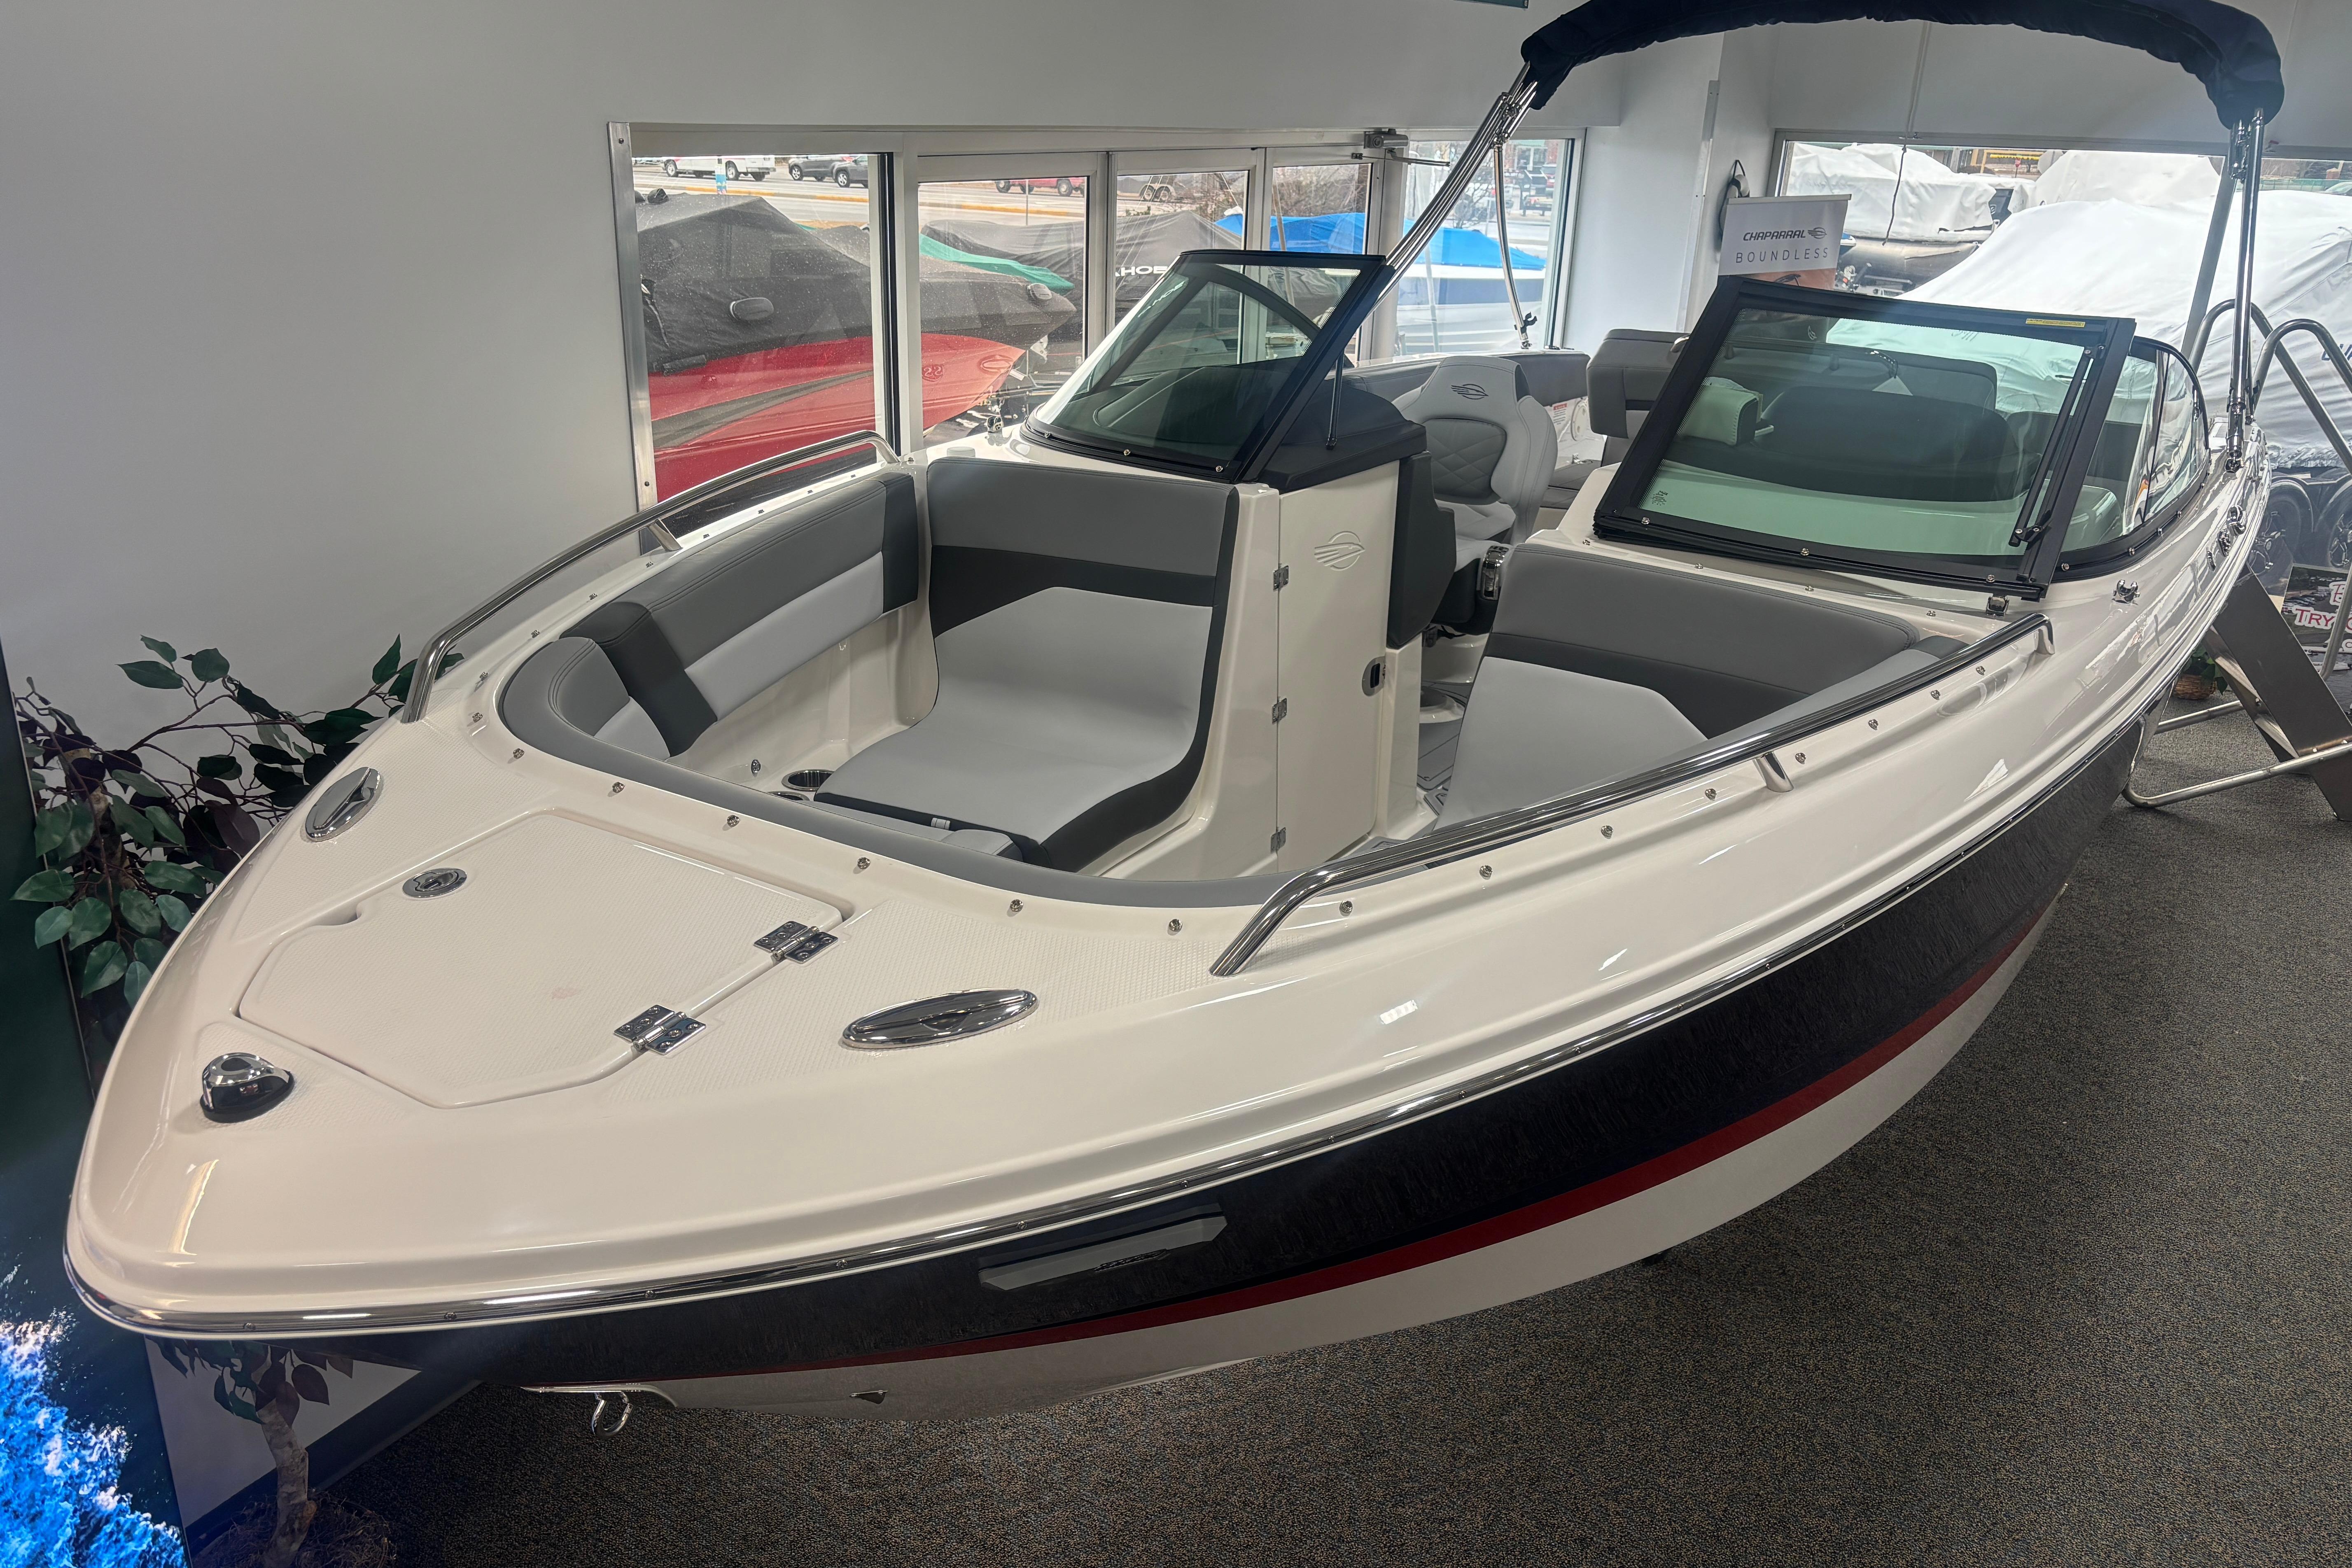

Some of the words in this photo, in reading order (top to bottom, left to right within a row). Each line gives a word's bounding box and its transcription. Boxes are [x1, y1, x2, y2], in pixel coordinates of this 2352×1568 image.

[1743, 229, 1806, 241] CHAPARRAL
[1736, 247, 1828, 263] BOUNDLESS
[2295, 608, 2336, 627] TRY
